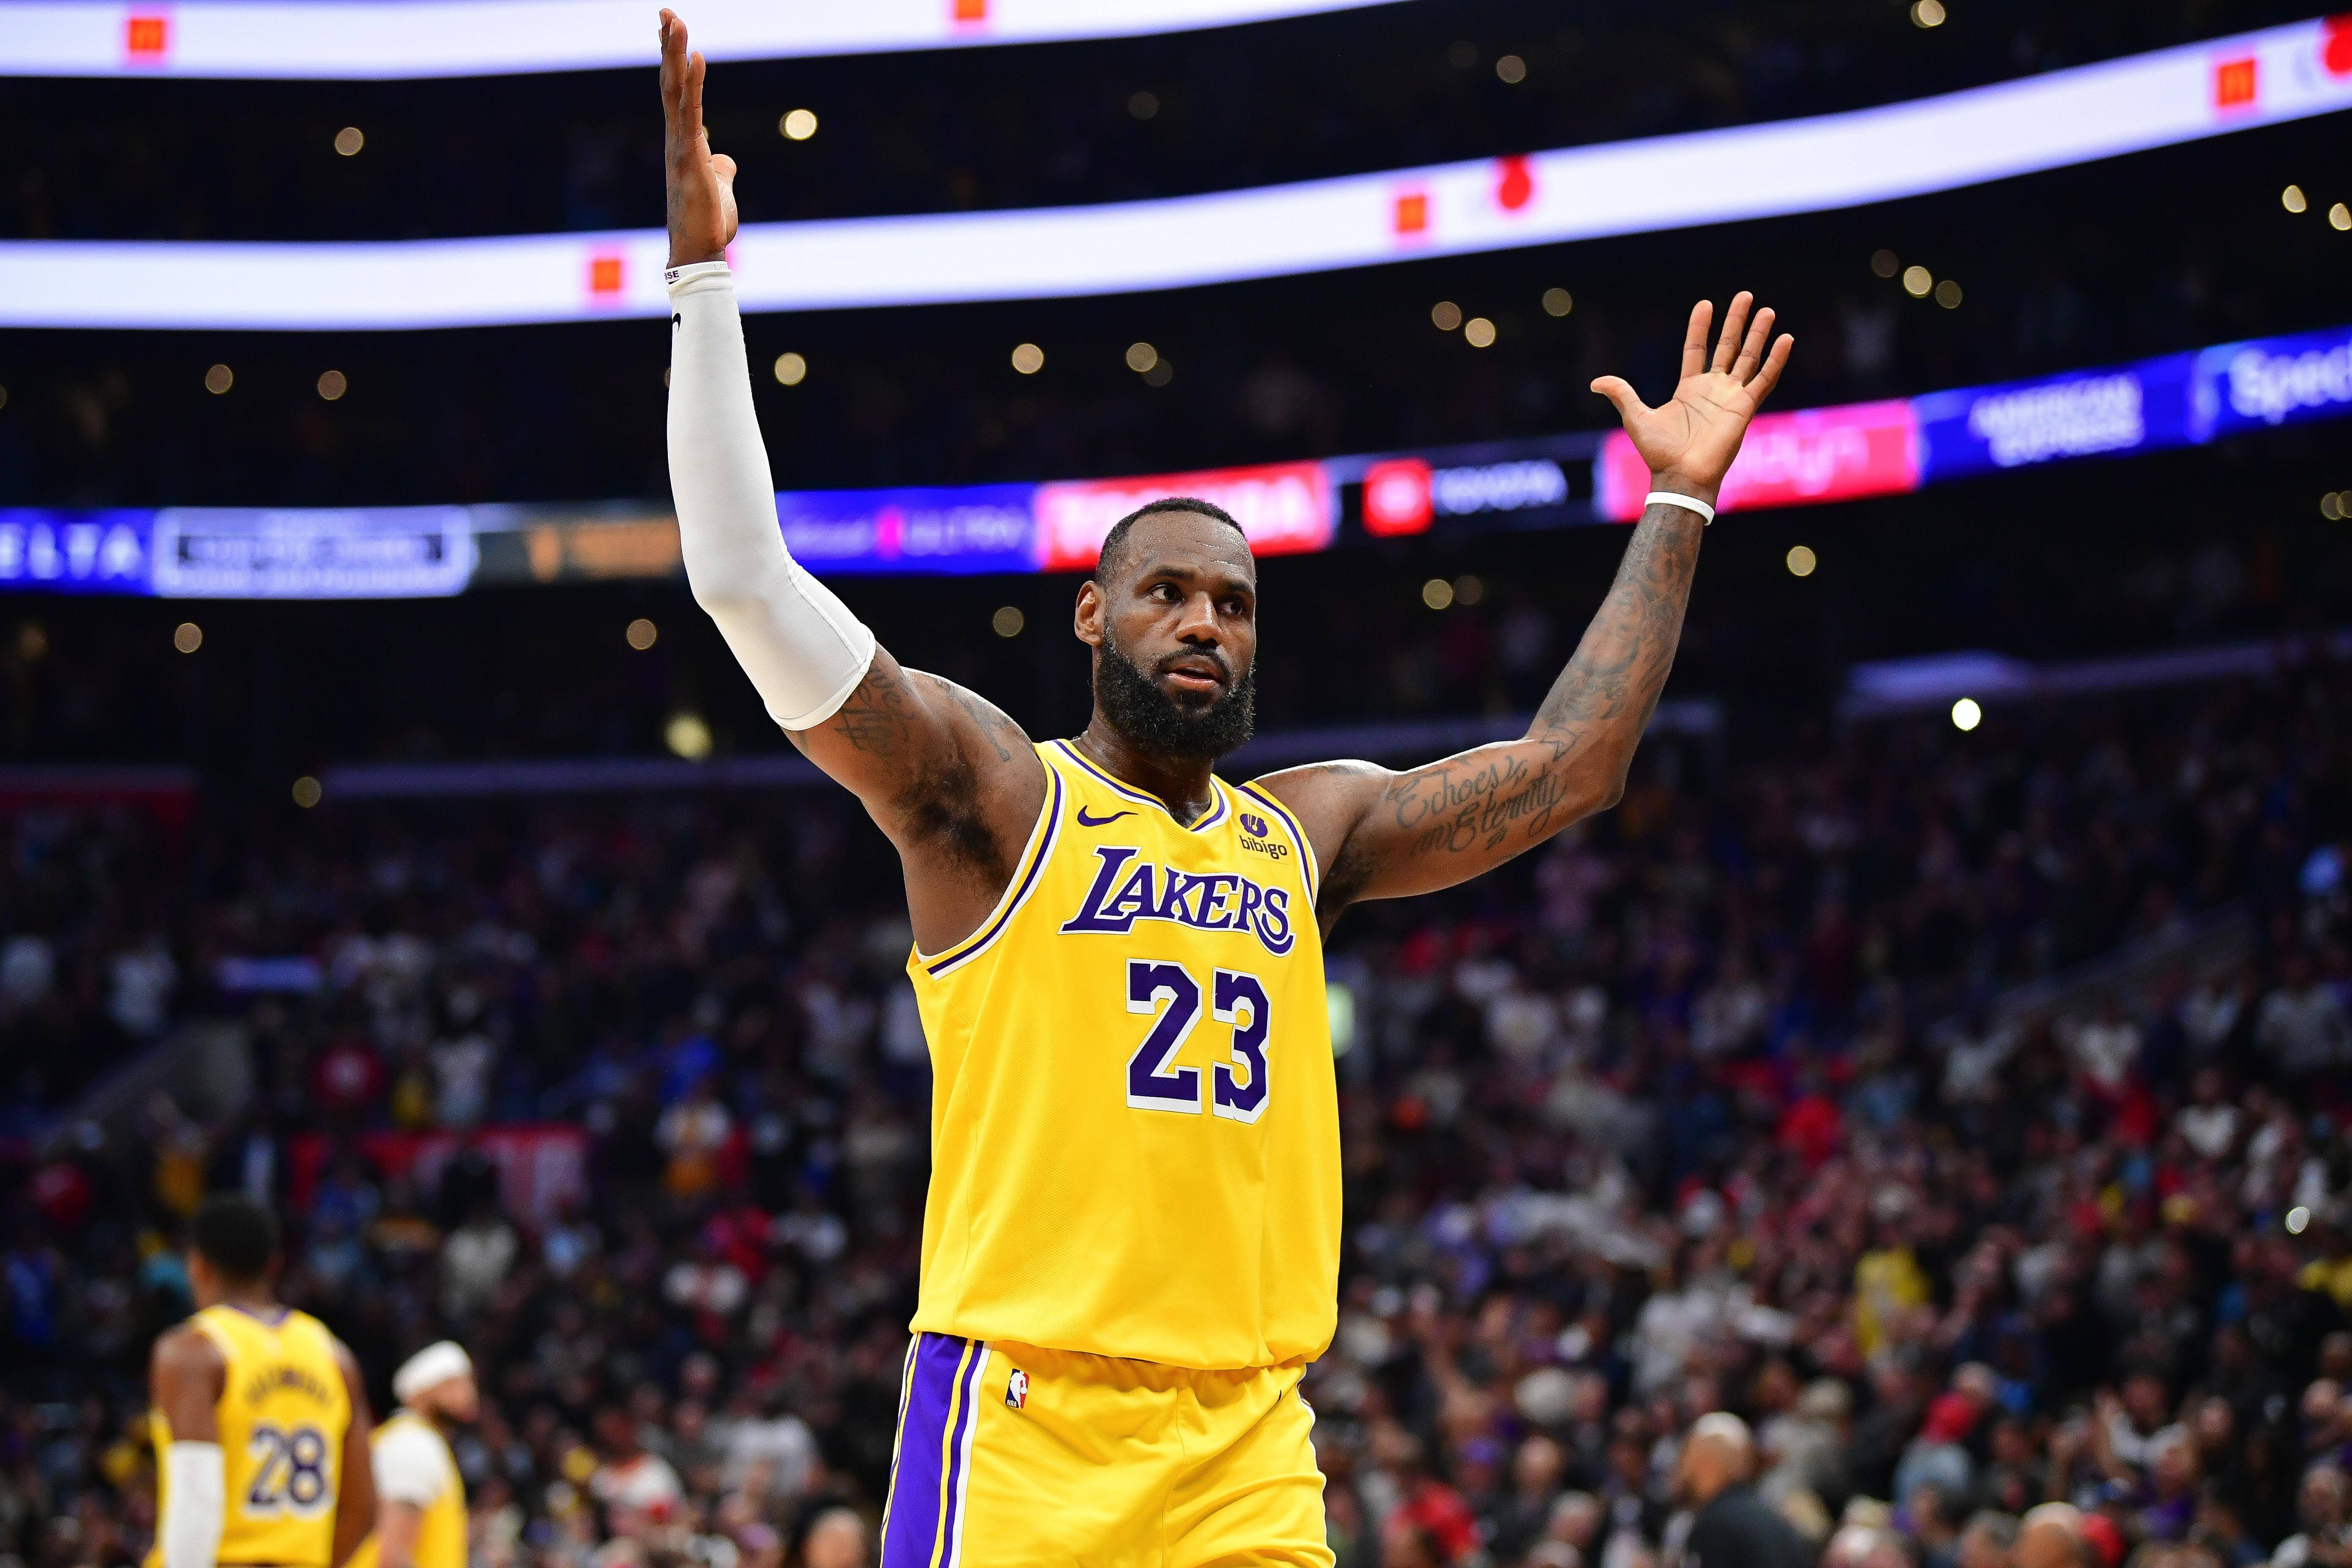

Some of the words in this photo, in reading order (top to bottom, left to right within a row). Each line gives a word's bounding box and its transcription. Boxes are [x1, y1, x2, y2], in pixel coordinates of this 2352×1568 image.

[664, 270, 680, 280] ISE
[1239, 835, 1288, 860] bibigo
[1057, 844, 1297, 957] LAKERS
[1126, 958, 1272, 1124] 23
[1007, 1399, 1017, 1407] NBA
[246, 1421, 333, 1518] 28
